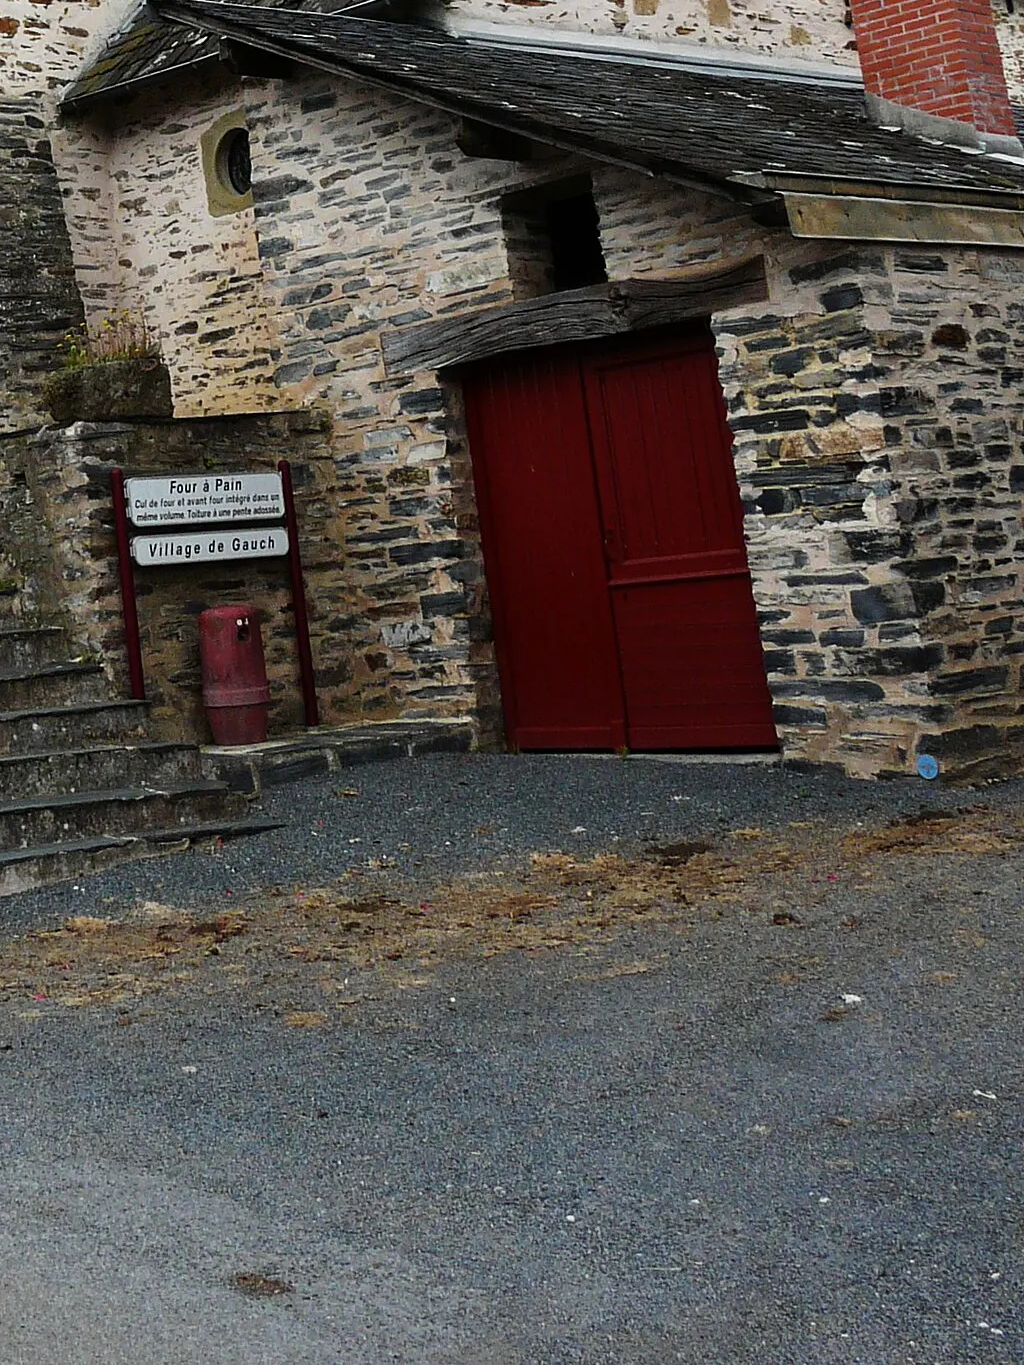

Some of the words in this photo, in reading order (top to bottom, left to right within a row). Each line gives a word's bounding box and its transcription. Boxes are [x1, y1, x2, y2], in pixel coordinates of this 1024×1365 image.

[169, 480, 197, 494] Four
[203, 479, 210, 492] à
[215, 478, 242, 492] Pain
[135, 499, 147, 509] Cul
[149, 499, 158, 508] de
[161, 498, 175, 508] four
[178, 497, 185, 506] et
[187, 496, 207, 506] avant
[209, 495, 223, 505] four
[225, 494, 250, 505] intégré
[252, 493, 269, 503] dans
[136, 512, 158, 522] même
[187, 509, 211, 519] Toiture
[212, 508, 217, 517] à
[218, 508, 231, 517] une
[233, 507, 251, 517] pente
[149, 541, 201, 558] Village
[208, 539, 224, 553] de
[232, 536, 275, 551] Gauch
